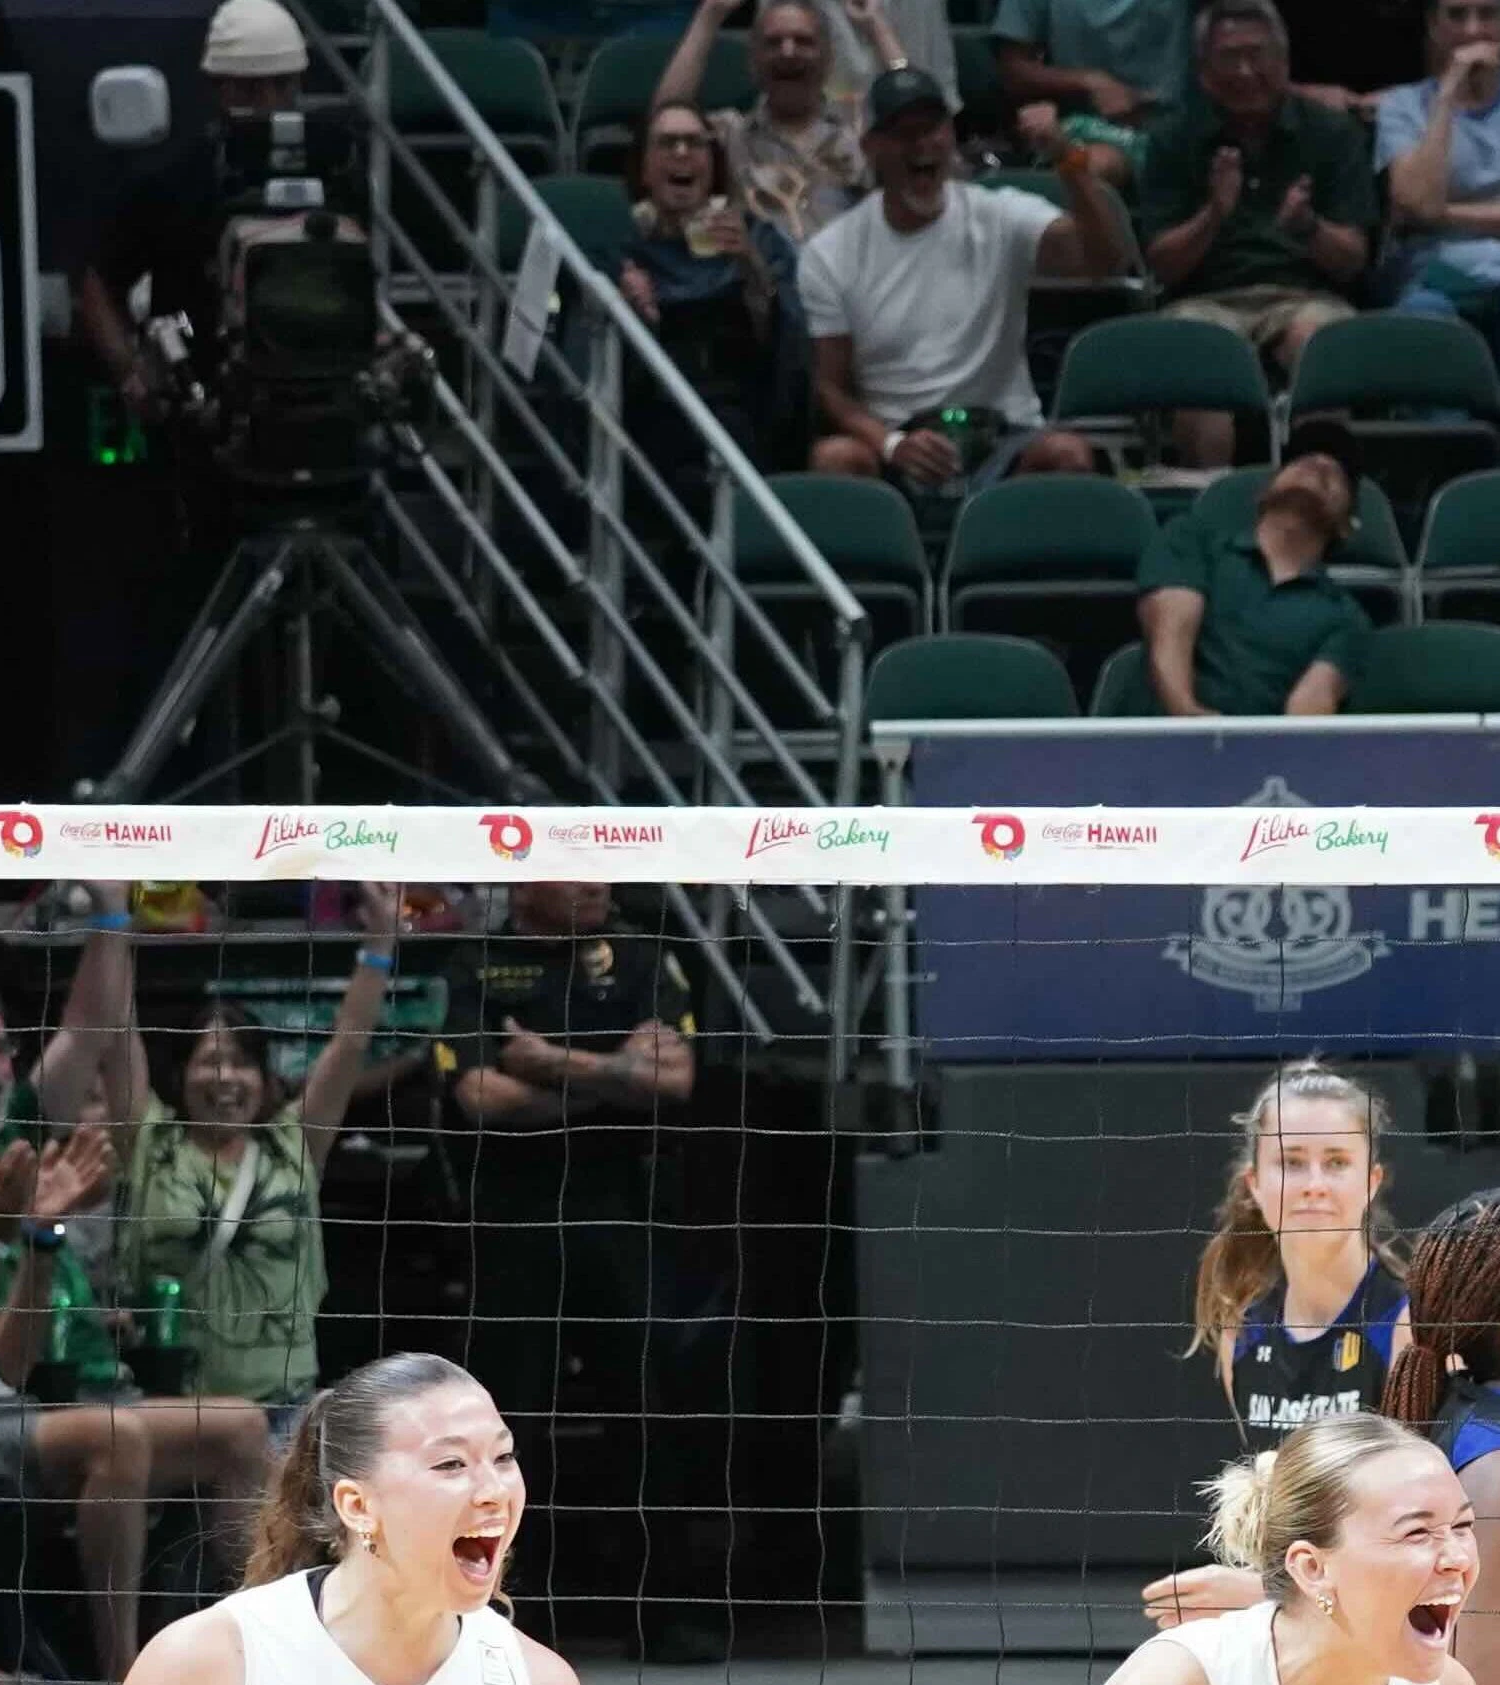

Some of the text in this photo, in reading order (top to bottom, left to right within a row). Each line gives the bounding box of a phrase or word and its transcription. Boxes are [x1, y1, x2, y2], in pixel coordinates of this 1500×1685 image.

[104, 821, 172, 841] HAWAII
[254, 815, 399, 860] Liliha Bakery
[593, 823, 663, 843] HAWAII
[745, 817, 890, 859] Liliha Bakery
[1087, 823, 1157, 843] HAWAII
[1240, 817, 1389, 862] Liliha Bakery
